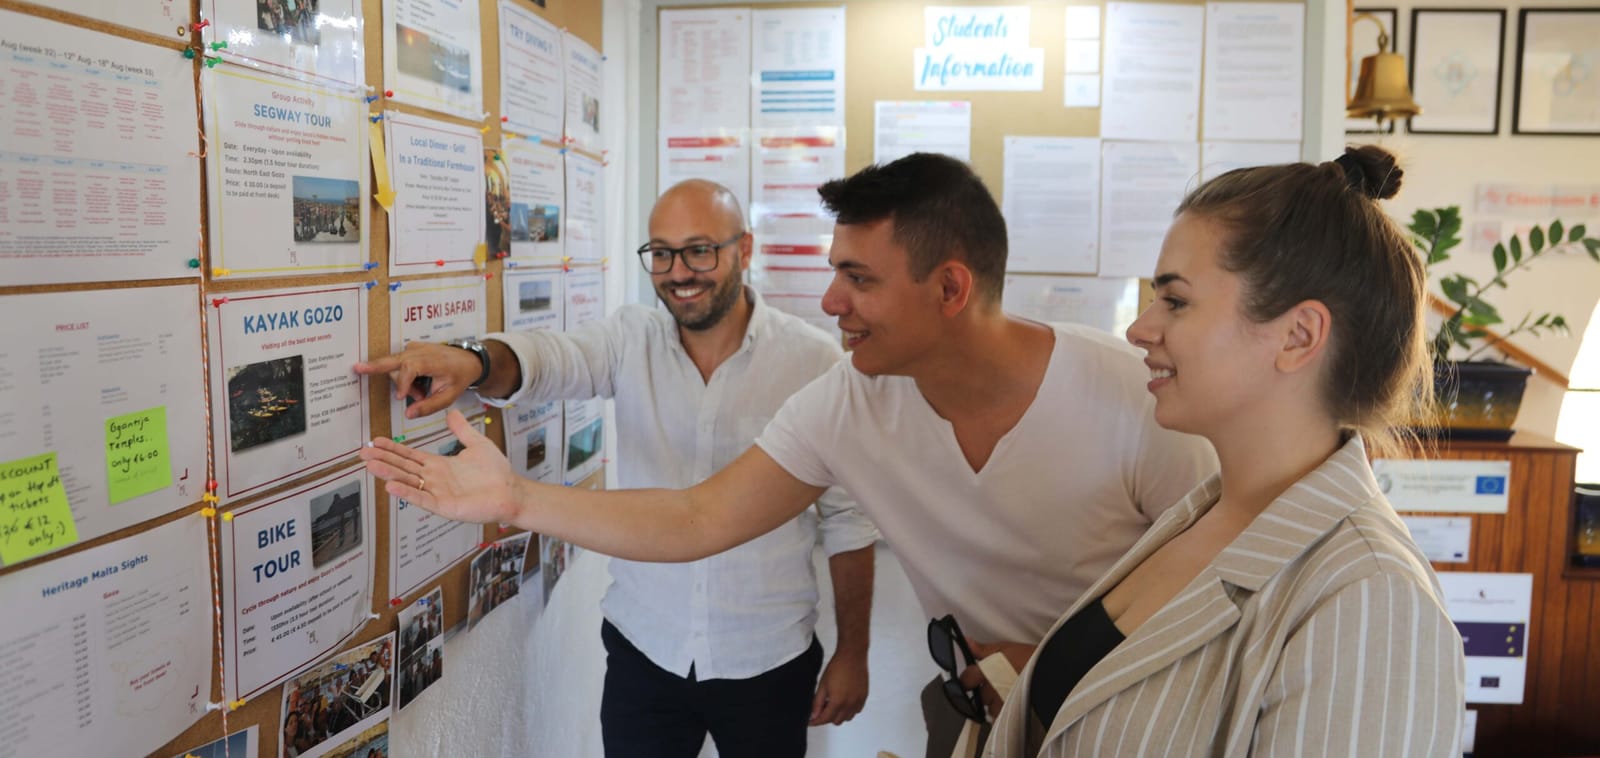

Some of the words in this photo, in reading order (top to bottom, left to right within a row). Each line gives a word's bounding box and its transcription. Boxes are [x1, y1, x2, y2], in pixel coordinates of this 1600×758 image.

[933, 13, 1008, 47] Students
[921, 52, 1035, 87] Information
[271, 91, 291, 102] Group
[291, 94, 315, 108] Activity
[253, 103, 302, 123] SEGWAY
[304, 112, 332, 129] TOUR
[242, 144, 267, 155] Everyday
[410, 135, 428, 148] Local
[428, 139, 449, 151] Dinner
[413, 156, 446, 168] Traditional
[243, 309, 300, 335] KAYAK
[303, 304, 344, 327] GOZO
[404, 305, 424, 323] JET
[426, 303, 442, 319] SKI
[445, 299, 476, 317] SAFARI
[55, 323, 75, 332] PRICE
[76, 321, 90, 330] LIST
[257, 518, 296, 549] BIKE
[42, 576, 89, 598] Heritage
[91, 565, 119, 581] Malta
[121, 554, 150, 571] Sights
[253, 549, 301, 584] TOUR
[241, 604, 257, 616] Cycle
[257, 593, 279, 608] through
[280, 586, 297, 598] nature
[298, 580, 307, 590] and
[307, 574, 320, 586] enjoy
